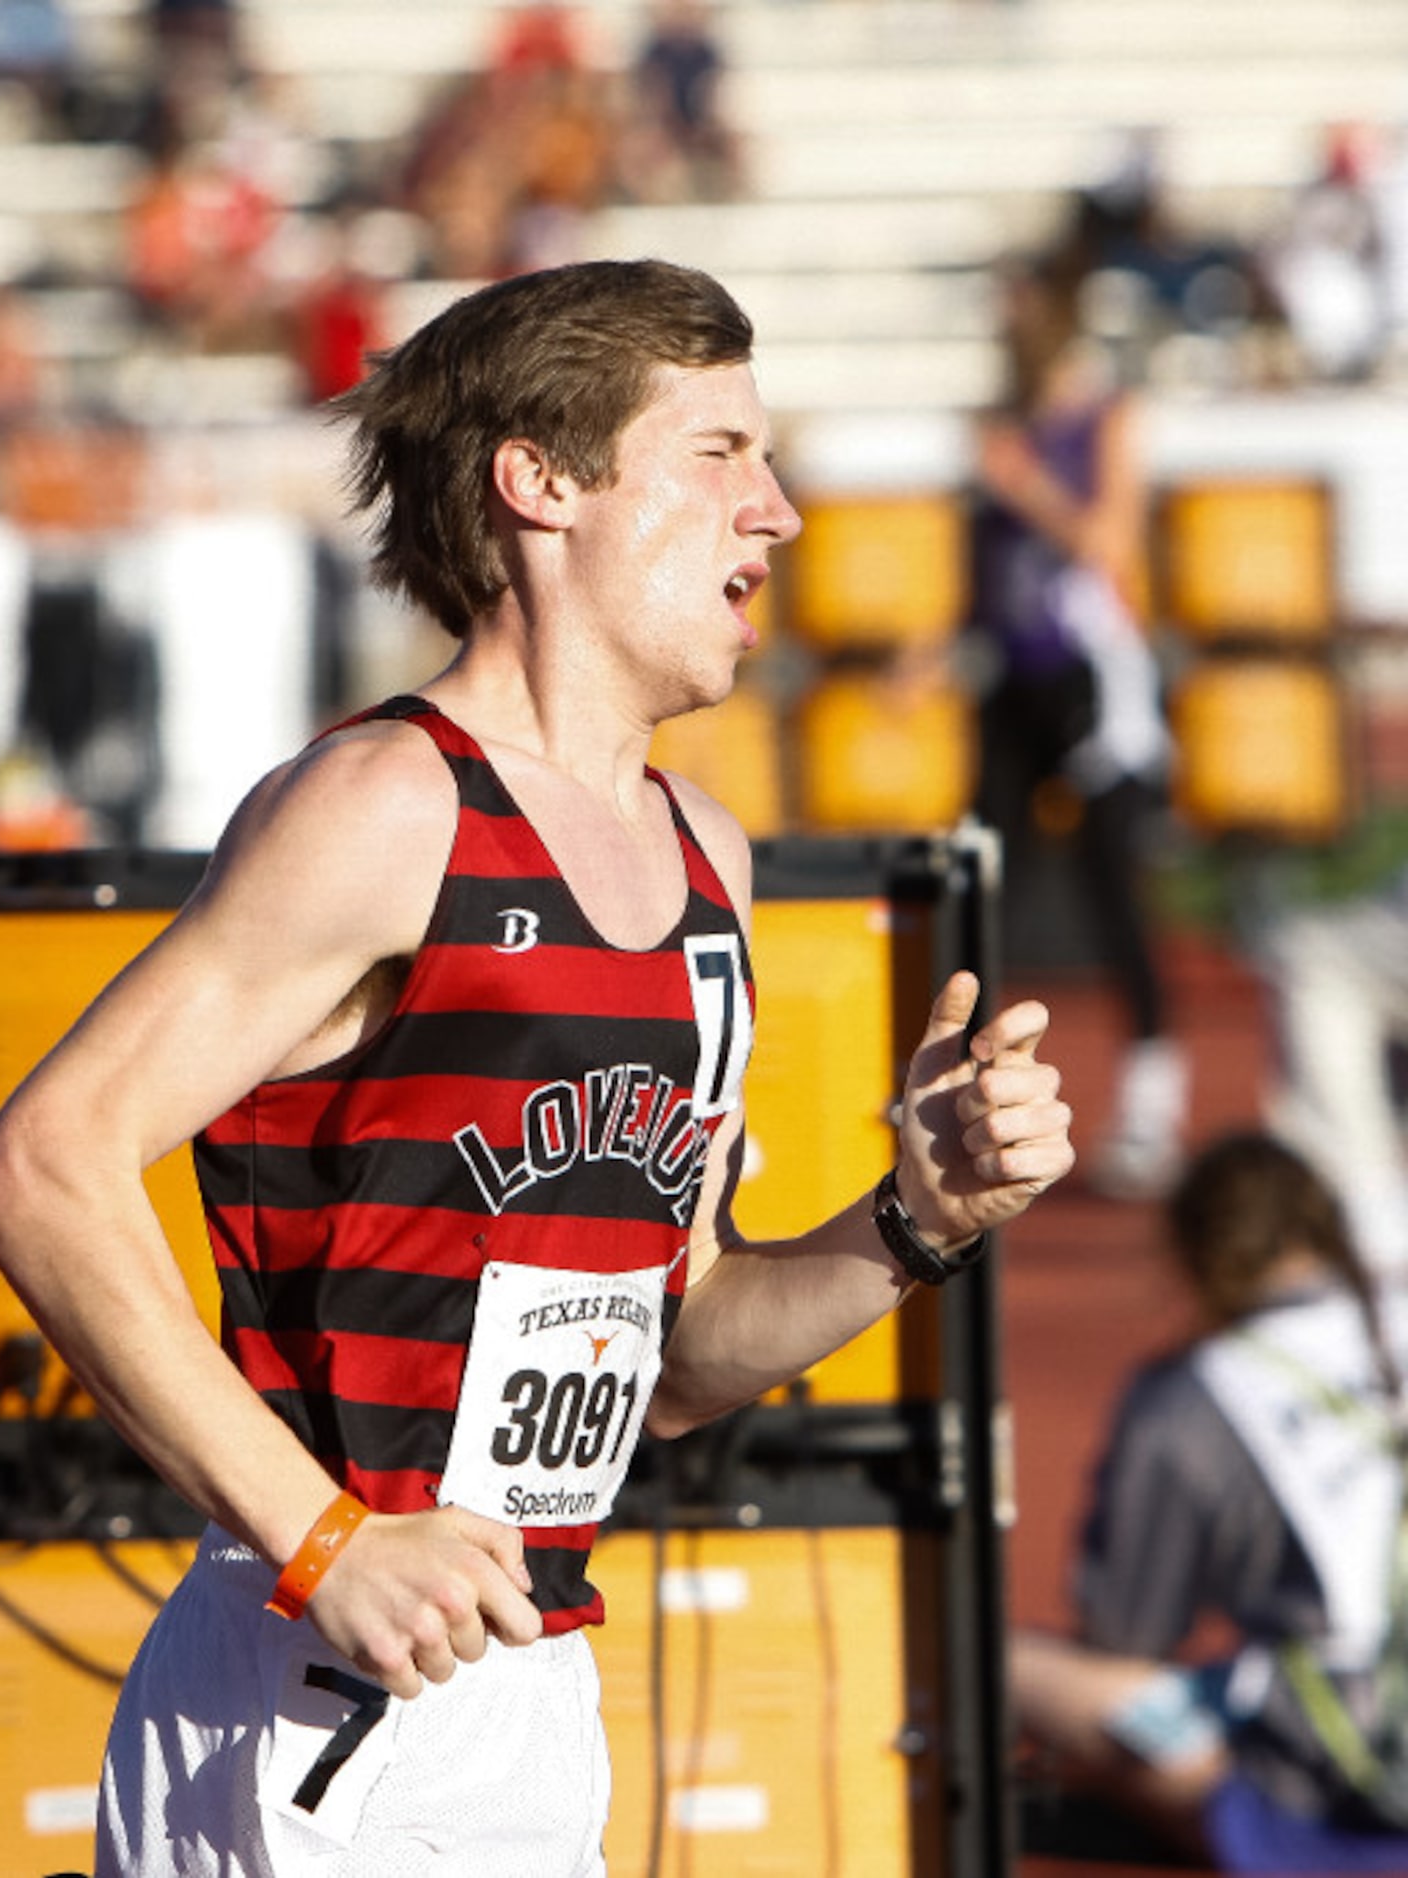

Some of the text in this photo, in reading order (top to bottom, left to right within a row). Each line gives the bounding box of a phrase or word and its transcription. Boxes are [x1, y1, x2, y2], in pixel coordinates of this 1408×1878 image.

[491, 908, 541, 953] B
[695, 951, 735, 1105] 7
[519, 1296, 603, 1337] TEXAS
[490, 1369, 639, 1471] 3091
[503, 1485, 597, 1521] Spectrum
[292, 1663, 392, 1815] 7
